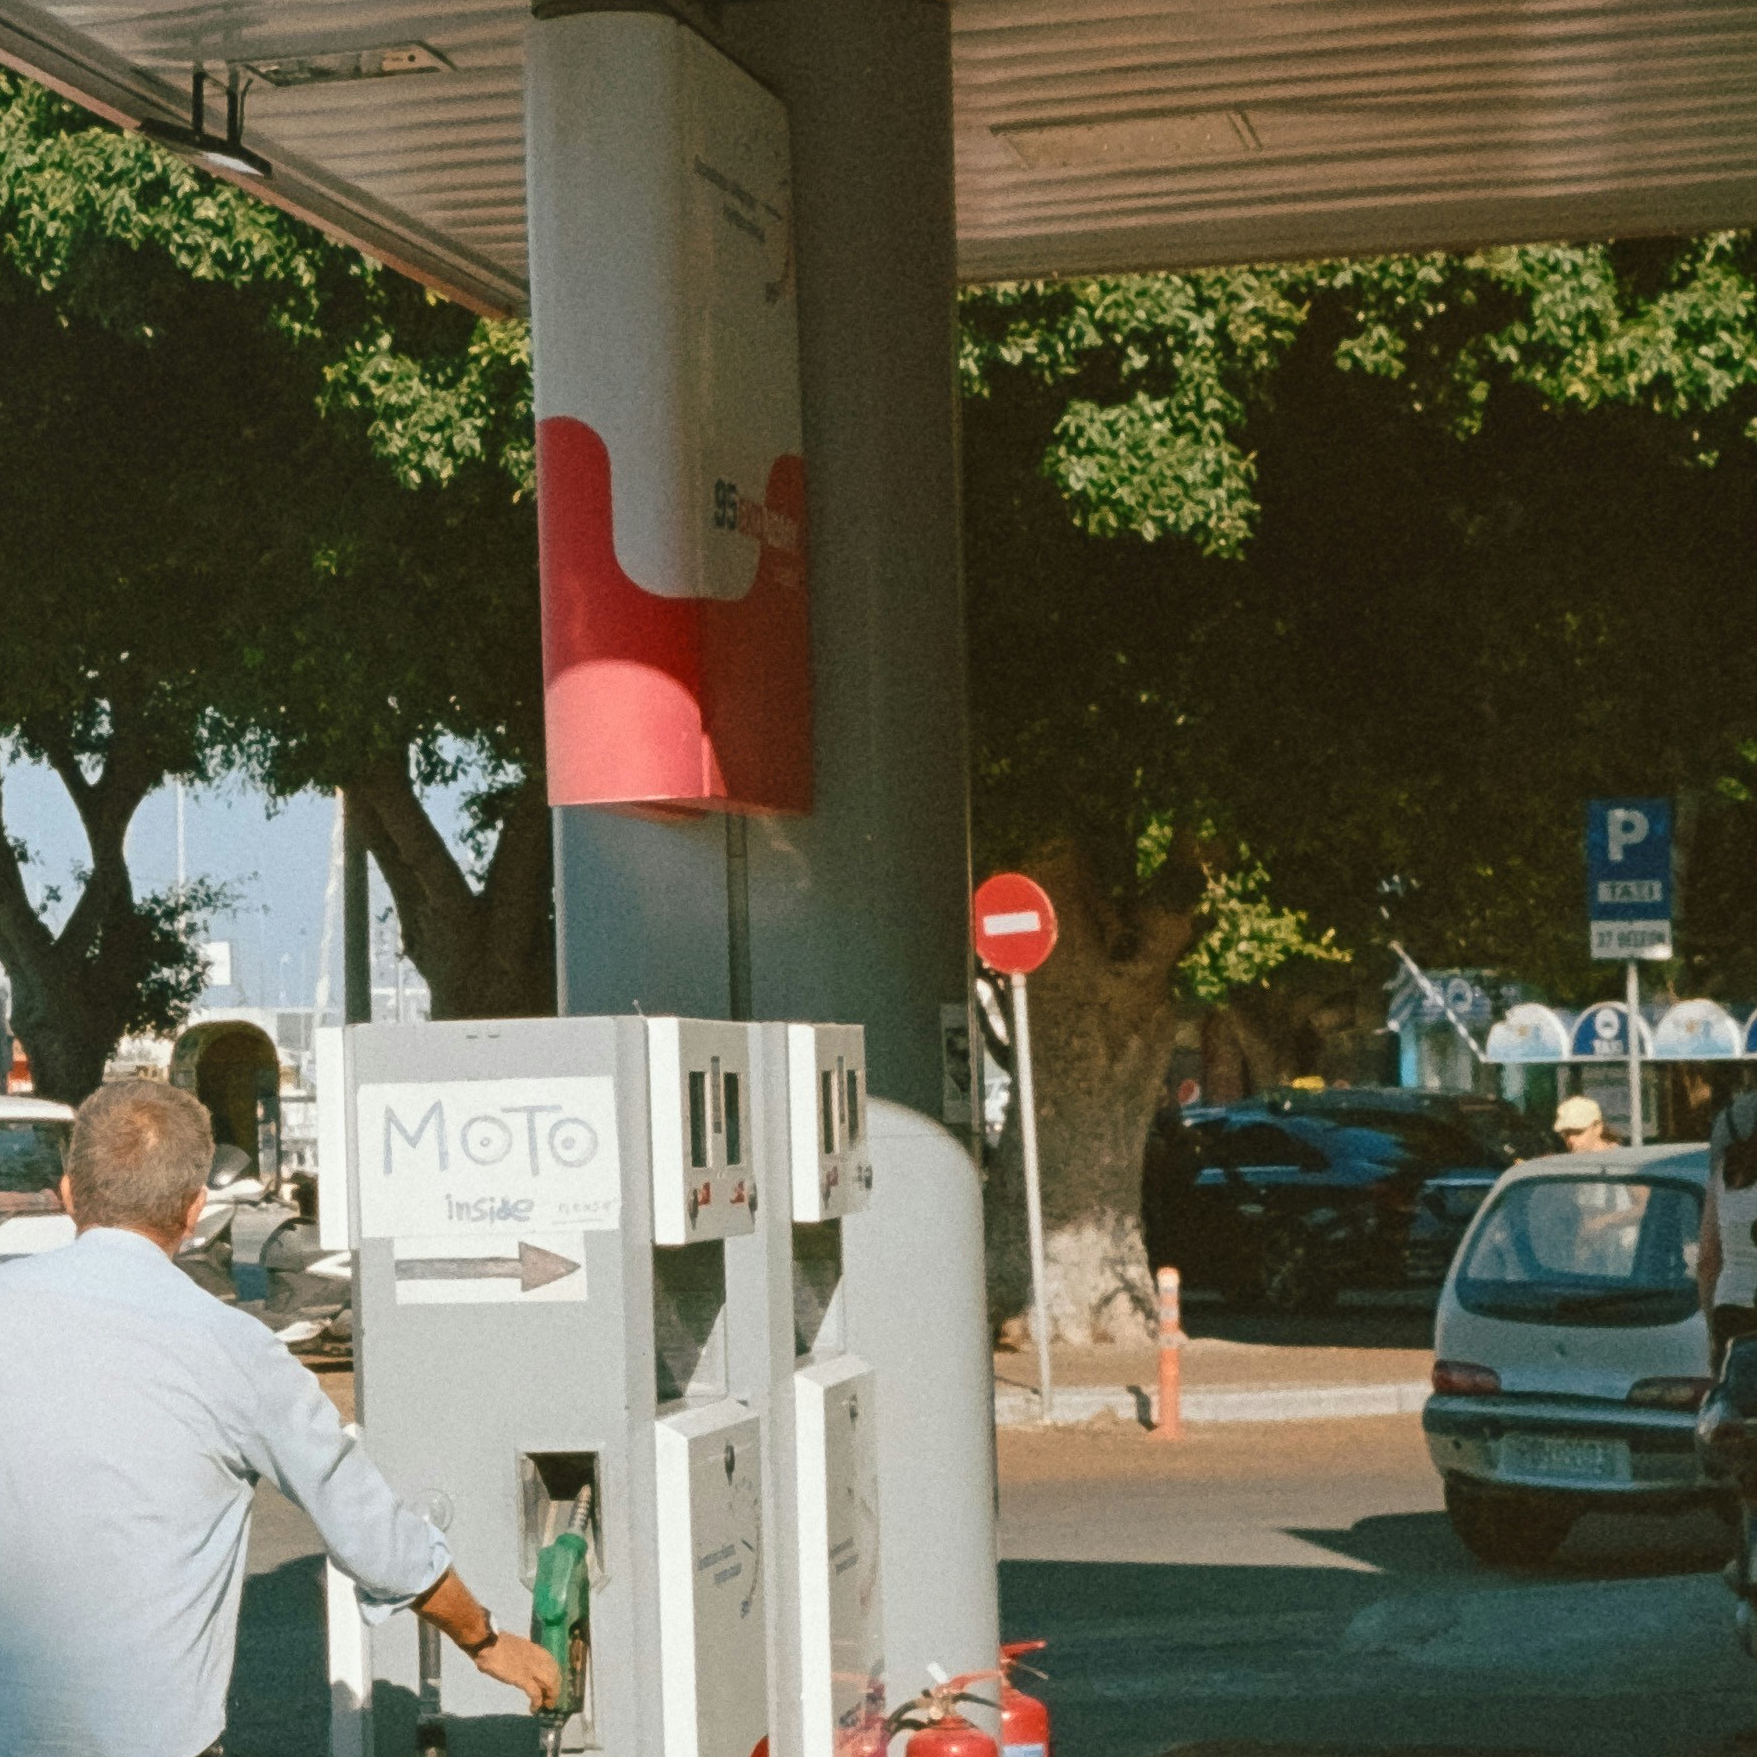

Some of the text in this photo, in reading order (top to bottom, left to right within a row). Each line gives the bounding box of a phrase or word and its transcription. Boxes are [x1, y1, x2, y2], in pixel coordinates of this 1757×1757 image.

[1608, 809, 1649, 862] P
[1609, 880, 1655, 900] TAXI
[445, 1193, 535, 1224] inside
